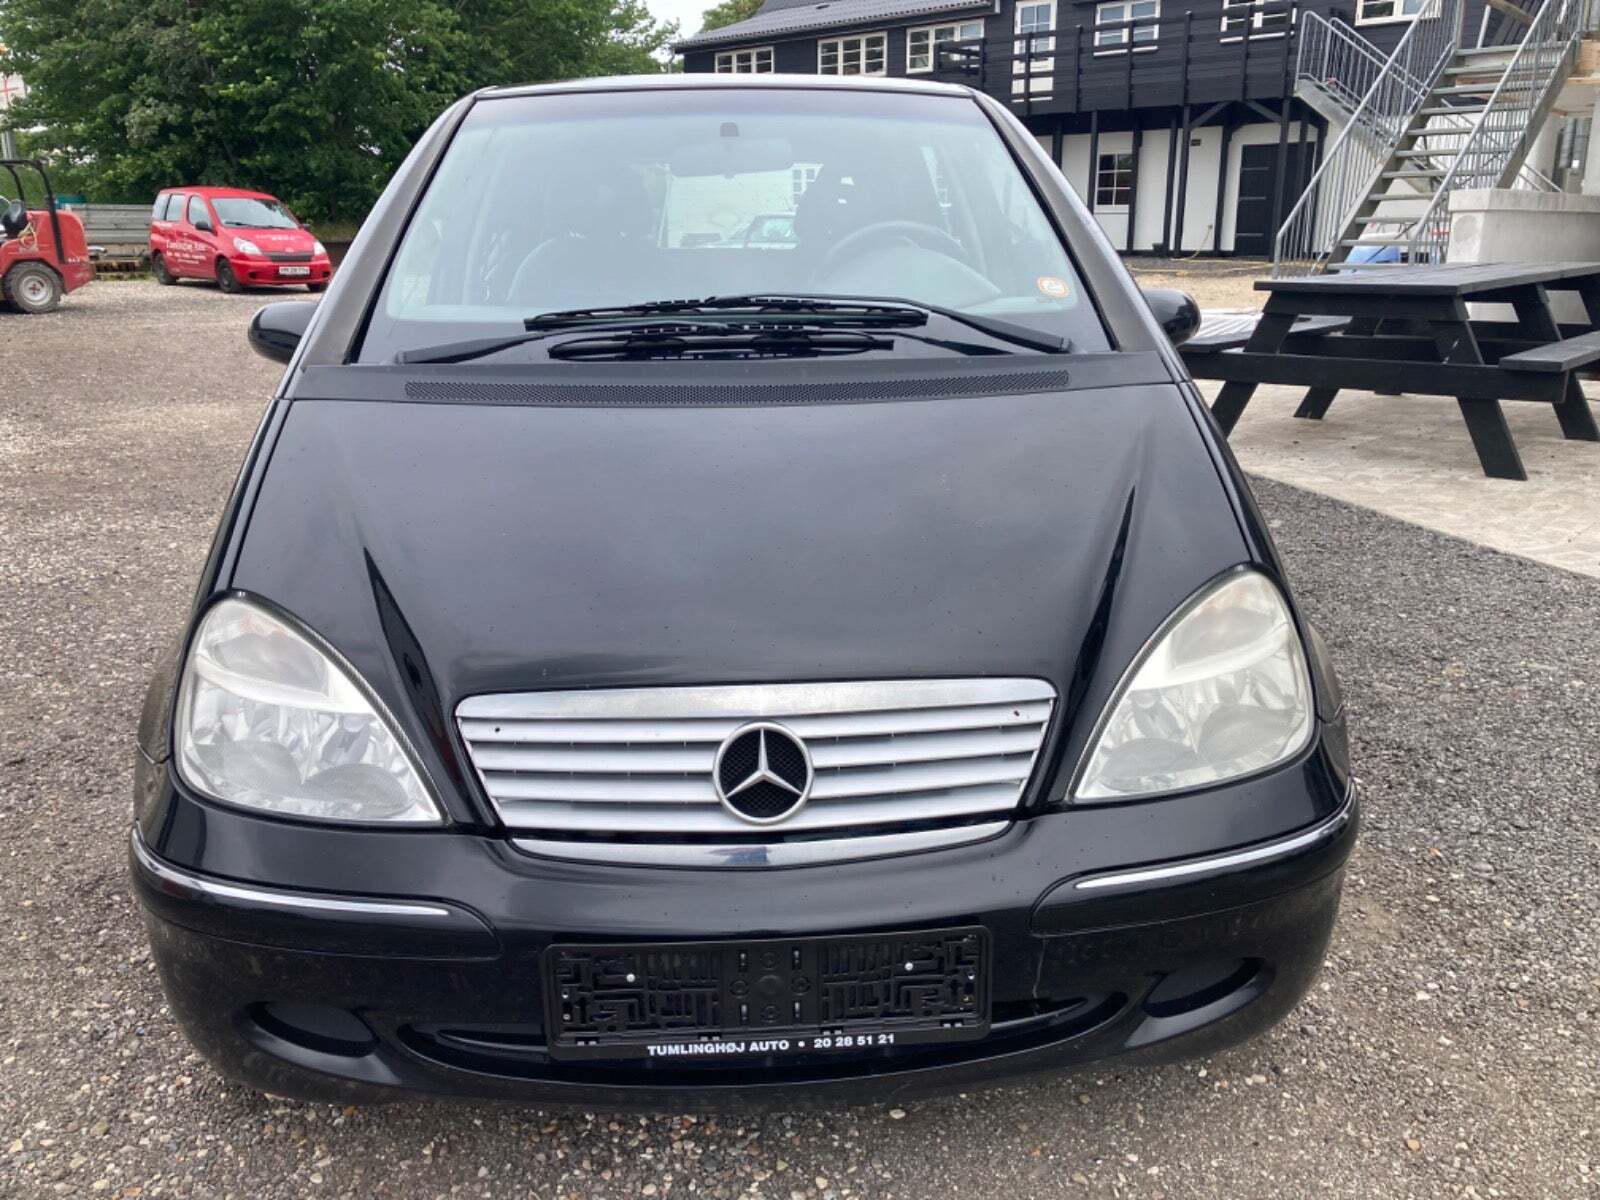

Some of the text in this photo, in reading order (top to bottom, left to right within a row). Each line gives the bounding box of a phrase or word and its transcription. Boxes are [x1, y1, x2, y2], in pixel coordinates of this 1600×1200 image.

[647, 1033, 895, 1056] TUMLINGHØJ AUTO 20 28 51 21
